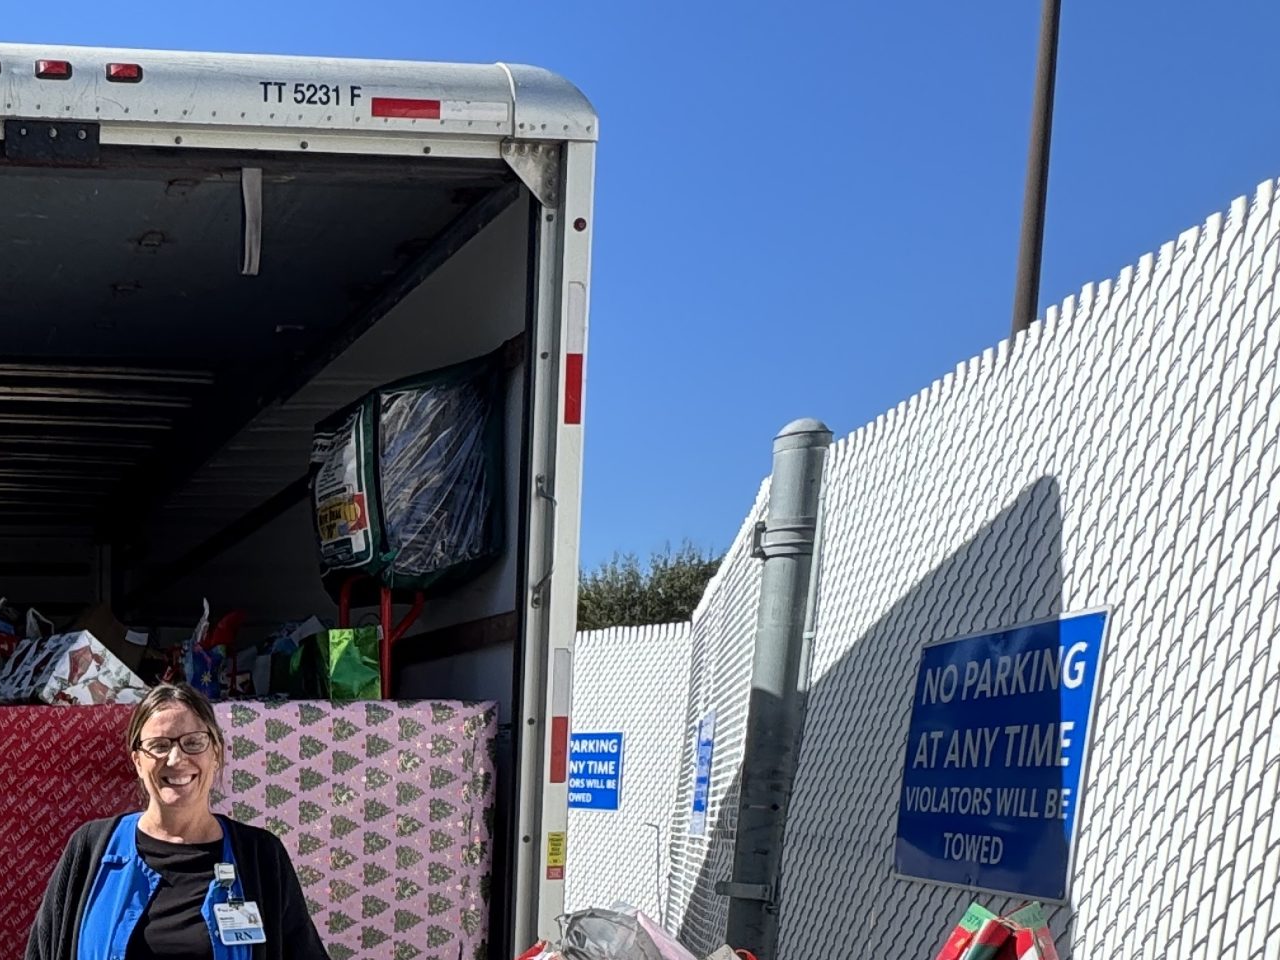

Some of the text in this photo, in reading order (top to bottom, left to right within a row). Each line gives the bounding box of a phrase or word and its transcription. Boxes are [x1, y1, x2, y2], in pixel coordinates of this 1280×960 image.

[259, 82, 362, 106] TT 5231 F
[922, 642, 1088, 705] NO PARKING
[913, 722, 1075, 769] AT ANY TIME
[569, 760, 616, 774] NY TIME
[586, 779, 605, 789] WILL
[606, 779, 616, 789] BE
[568, 792, 592, 803] OWED
[905, 786, 1072, 820] VIOLATORS WILL BE
[944, 832, 1004, 865] TOWED
[234, 931, 253, 941] RN
